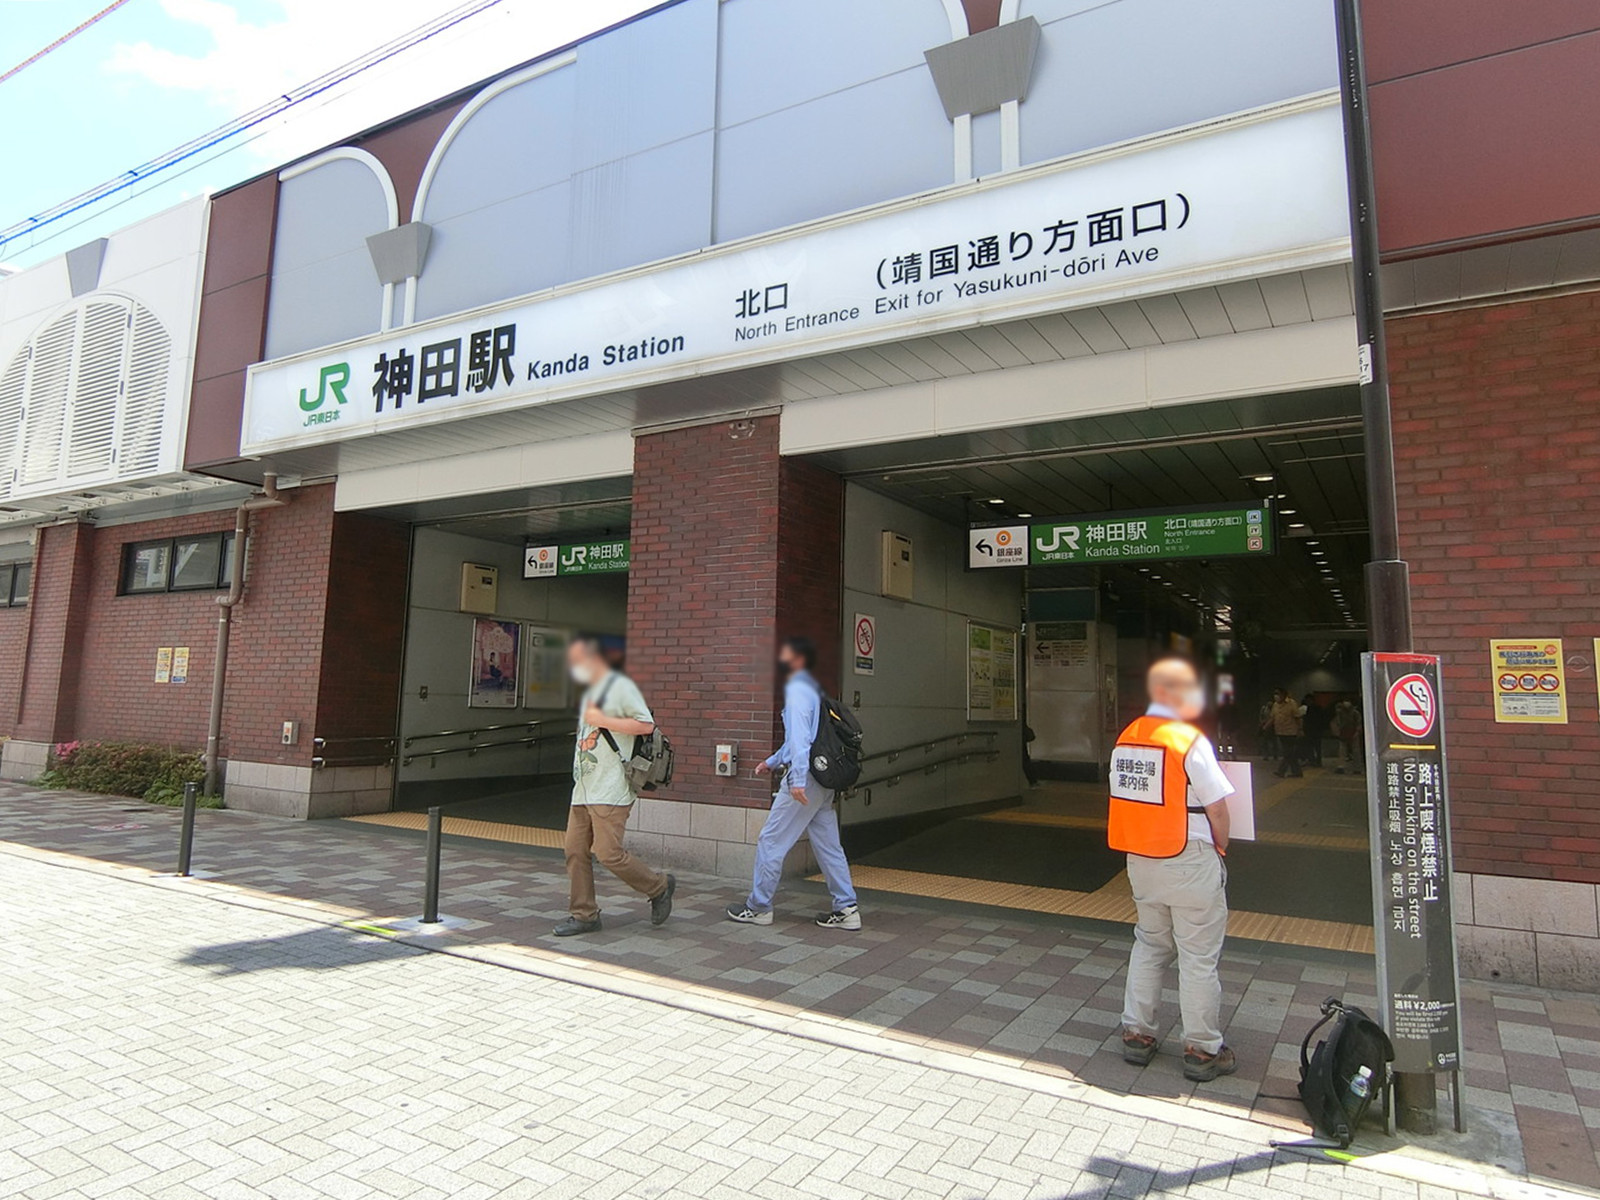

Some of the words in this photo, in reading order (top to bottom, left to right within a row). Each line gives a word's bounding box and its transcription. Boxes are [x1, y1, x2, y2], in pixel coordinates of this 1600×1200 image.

[875, 192, 1191, 289] (靖国通り方面口)
[874, 294, 910, 315] Exit
[916, 287, 944, 307] for
[952, 255, 1106, 300] Yasukuni-dōri
[1114, 245, 1160, 269] Ave
[734, 282, 789, 320] 北口
[734, 320, 778, 342] North
[784, 304, 860, 332] Entrance
[372, 322, 517, 413] 神田駅
[527, 352, 590, 382] Kanda
[602, 333, 686, 366] Station
[299, 362, 351, 412] JR
[302, 409, 341, 427] JR東日本
[1085, 521, 1148, 544] 神田駅
[1163, 518, 1187, 530] 北口
[1163, 530, 1184, 538] North
[1184, 528, 1216, 537] Entrance
[1036, 525, 1081, 552] JR
[561, 546, 587, 566] JR
[589, 543, 624, 560] 神田駅
[1041, 552, 1075, 560] JR東日本
[1084, 546, 1121, 558] Kanda
[1122, 543, 1161, 556] Station
[588, 561, 608, 570] Kanda
[1115, 757, 1157, 777] 接種会場
[1402, 763, 1417, 782] No
[1118, 773, 1149, 792] 案内係
[1403, 786, 1420, 845] Smoking
[1418, 762, 1439, 902] 路上喫煙禁止
[1389, 840, 1404, 866] 노상
[1407, 849, 1419, 868] on
[1407, 871, 1421, 895] the
[1392, 905, 1406, 933] 금지
[1408, 898, 1422, 939] street
[1413, 1000, 1440, 1011] ¥2,000
